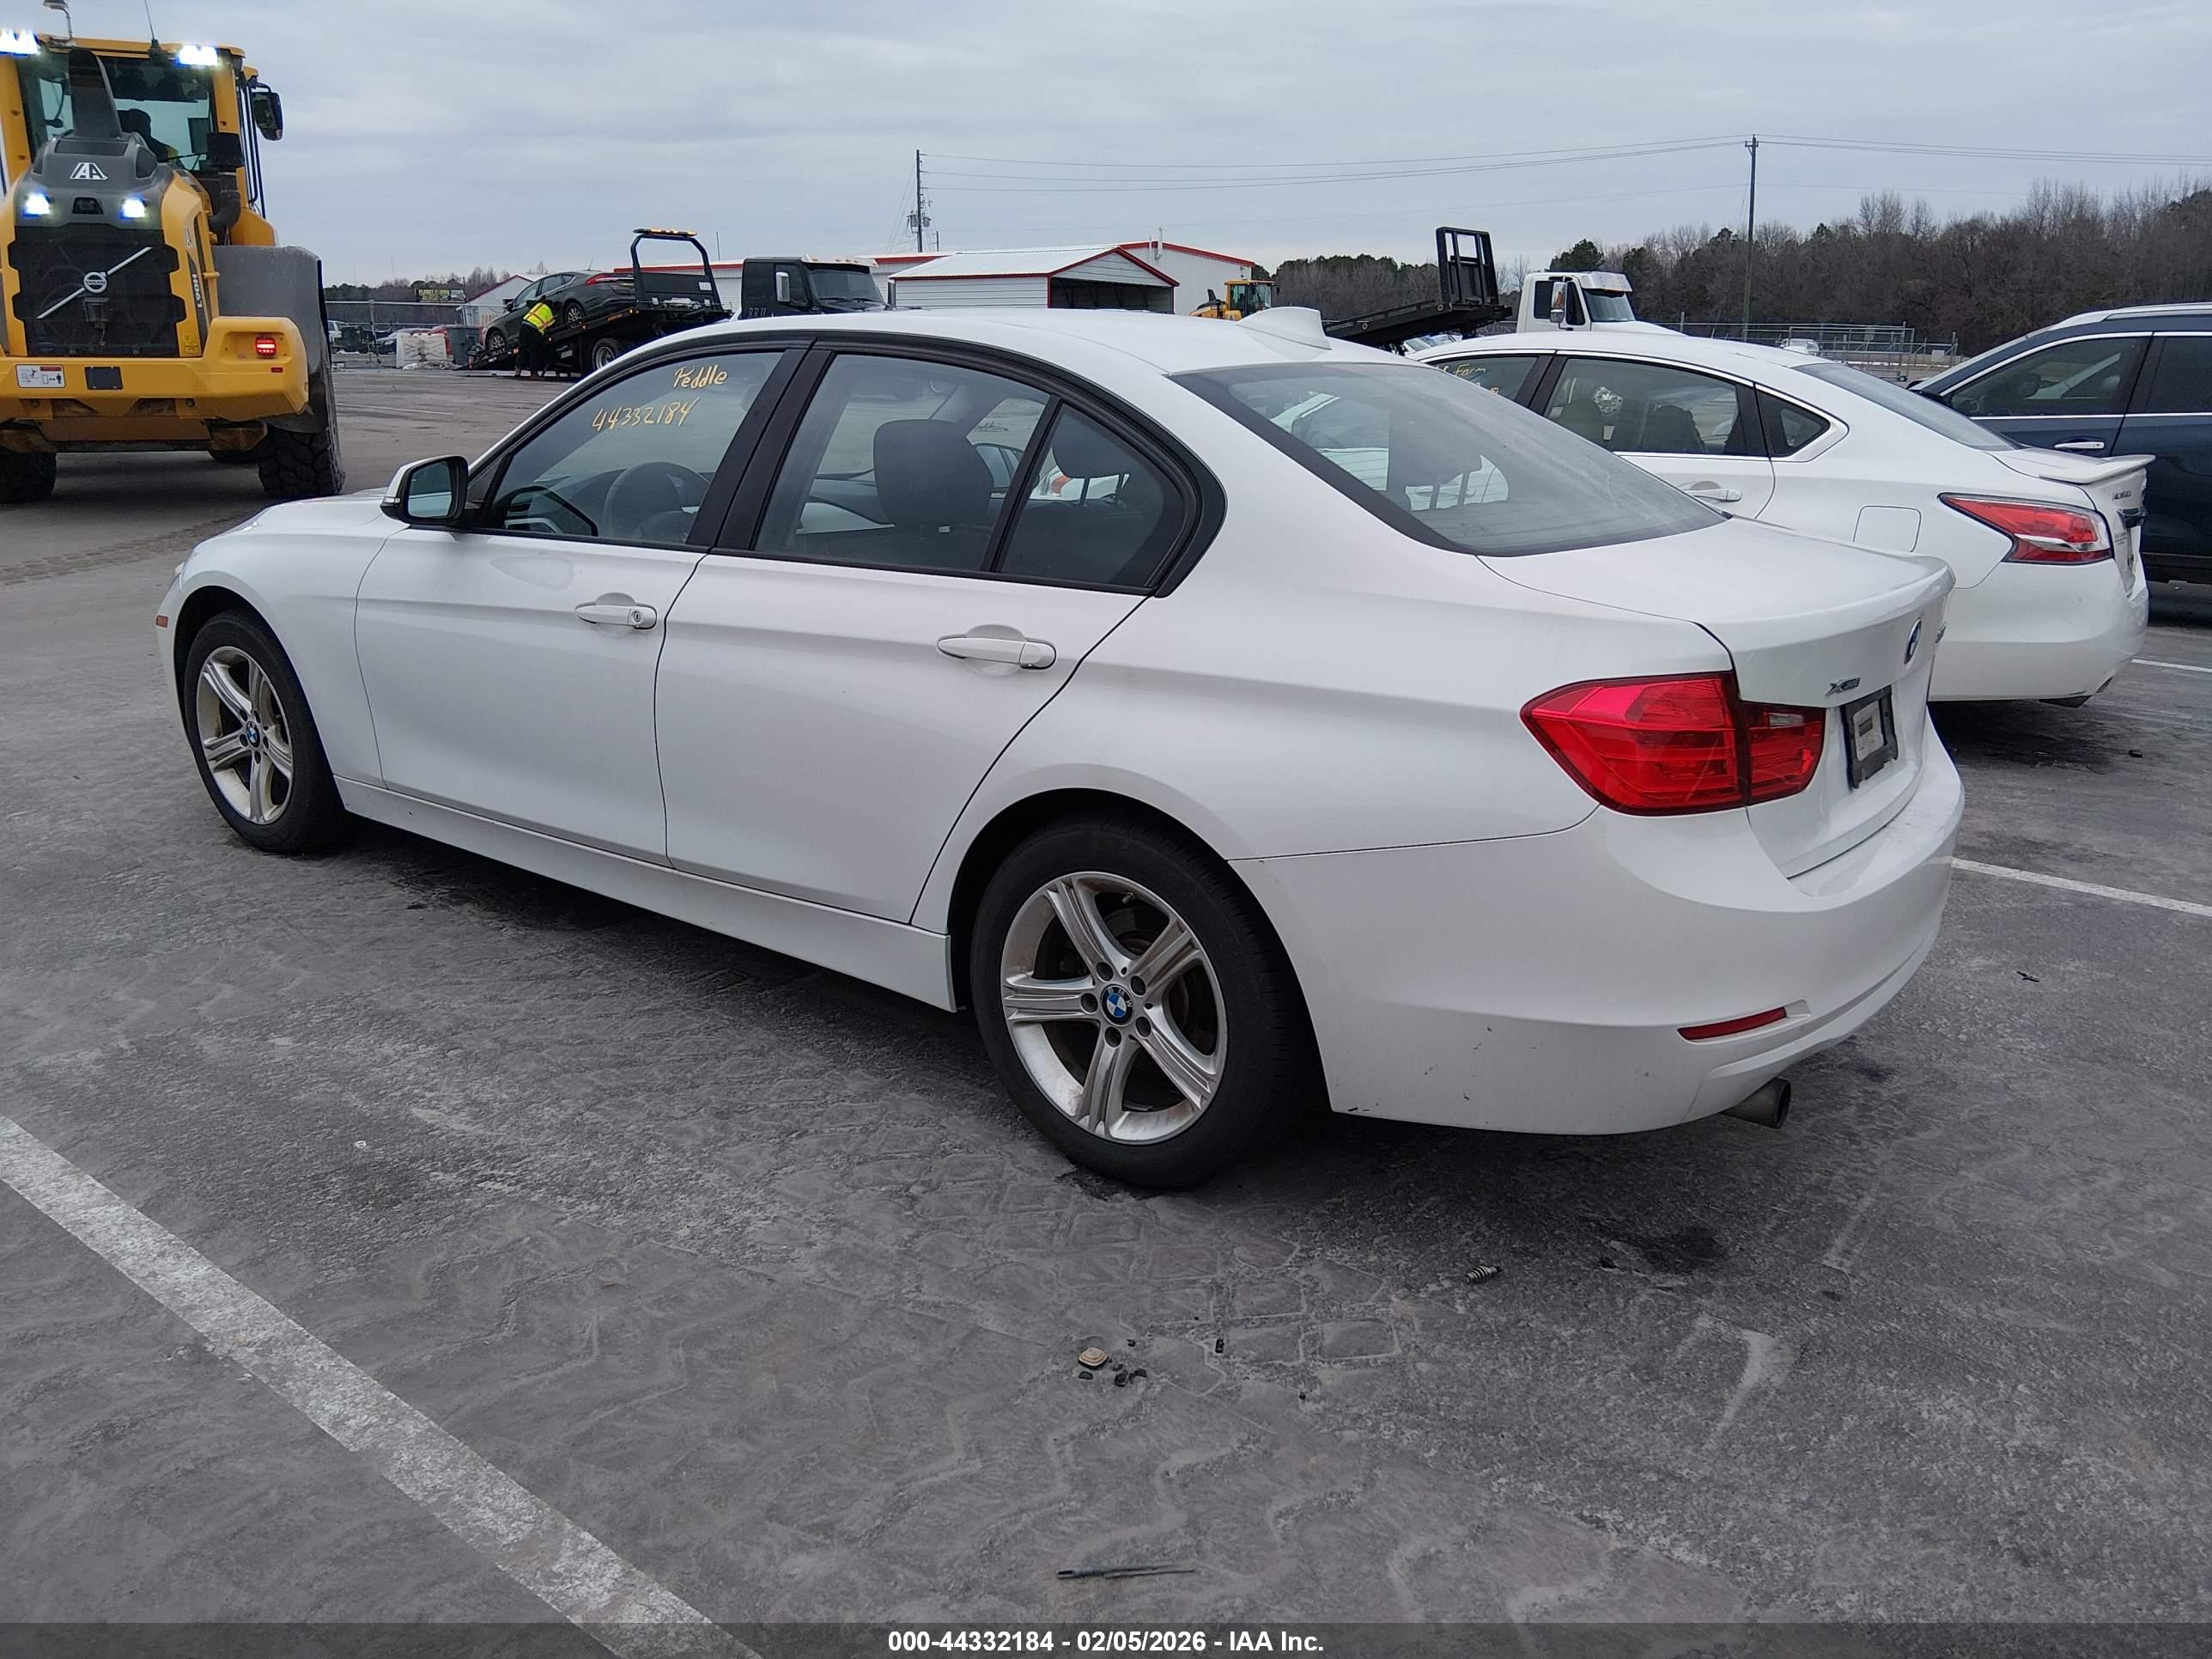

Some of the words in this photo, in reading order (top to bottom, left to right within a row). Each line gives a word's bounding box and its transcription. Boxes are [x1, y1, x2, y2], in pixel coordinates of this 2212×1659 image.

[673, 364, 729, 390] Peddle
[1453, 363, 1486, 376] Farm
[591, 398, 701, 432] 44332184
[1107, 986, 1133, 1008] BMW
